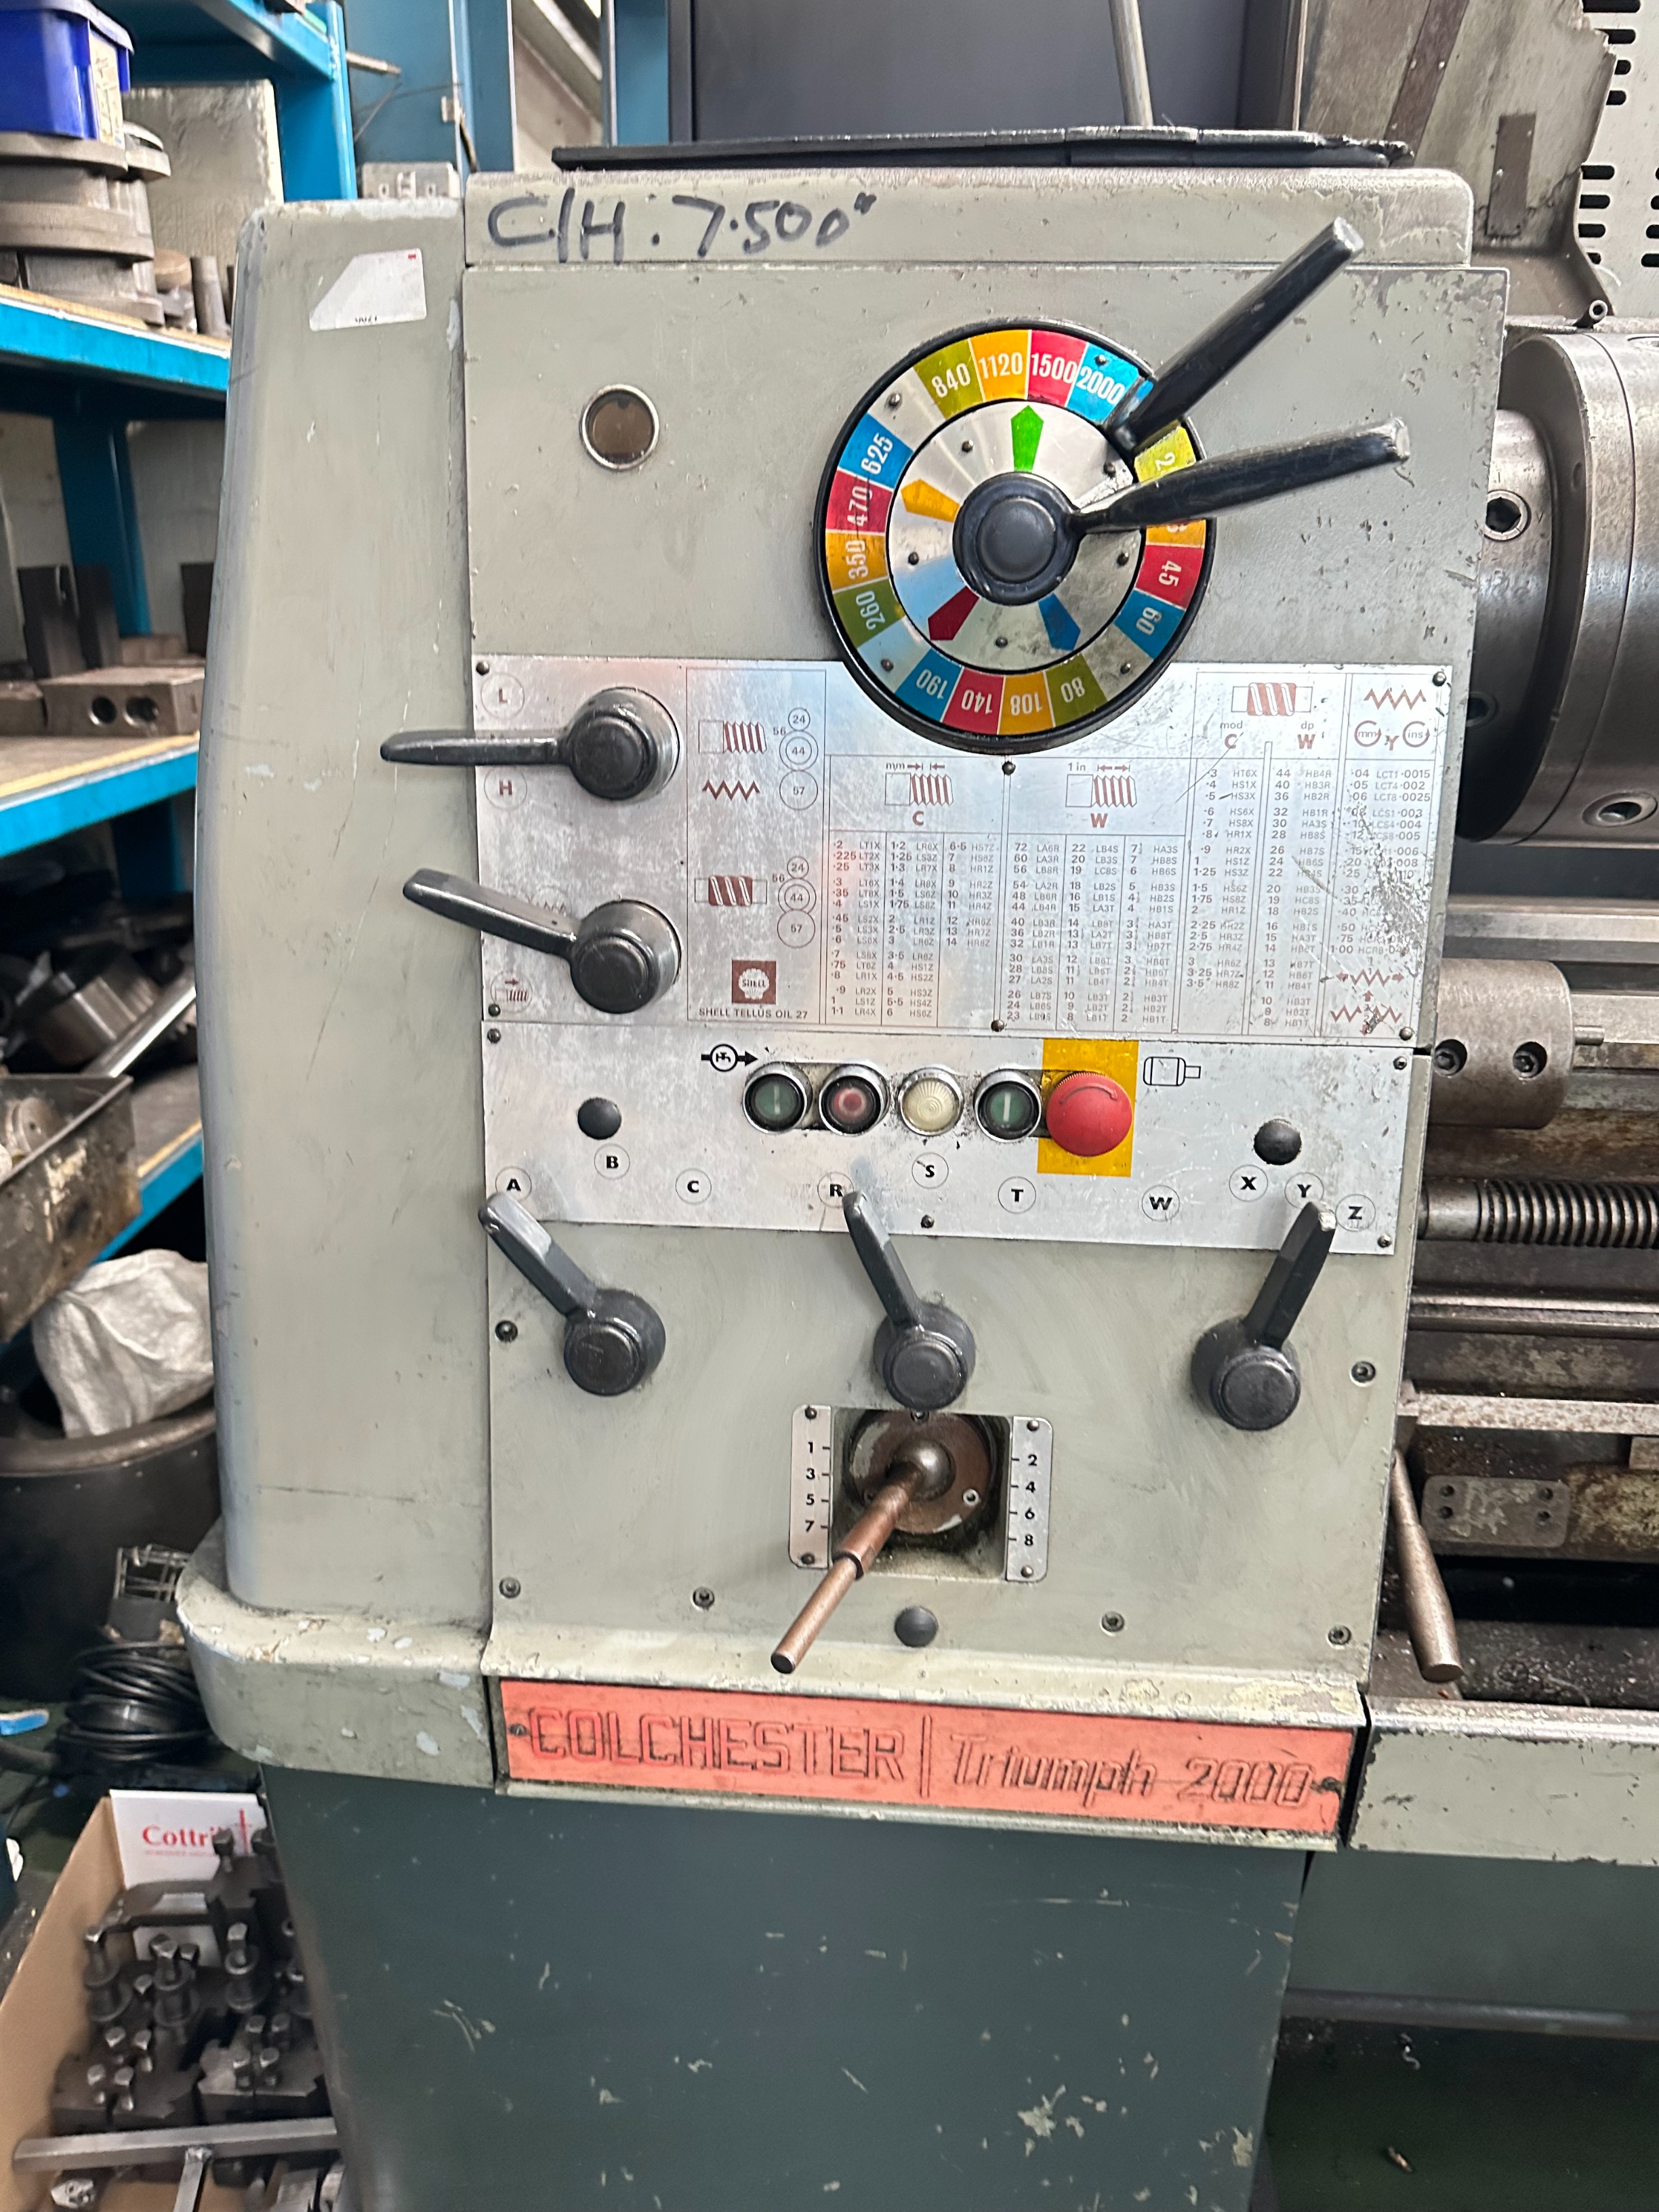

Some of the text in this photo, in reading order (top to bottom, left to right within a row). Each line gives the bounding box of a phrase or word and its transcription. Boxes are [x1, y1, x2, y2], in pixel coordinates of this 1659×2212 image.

[979, 352, 1023, 379] 1120
[1031, 353, 1077, 384] 1500
[931, 363, 971, 398] 840
[1080, 366, 1126, 405] 2000
[861, 432, 893, 474] 625
[1155, 452, 1177, 474] 2
[846, 486, 872, 527] 470
[846, 539, 869, 580] 350
[1159, 560, 1182, 586] 45
[855, 590, 886, 630] 260
[1136, 607, 1163, 634] 60
[916, 668, 949, 700] 190
[1060, 677, 1086, 703] 80
[499, 689, 508, 703] L
[961, 690, 993, 714] 140
[1009, 693, 1042, 714] 108
[793, 716, 805, 724] 24
[1220, 721, 1243, 729] mod
[1301, 721, 1314, 731] dp
[773, 727, 786, 735] 56
[1408, 729, 1423, 738] ins
[1225, 733, 1237, 749] C
[1297, 734, 1315, 749] W
[792, 747, 805, 755] 44
[499, 781, 512, 796] H
[912, 811, 924, 825] C
[1274, 808, 1287, 816] 32
[1090, 813, 1108, 827] W
[1072, 855, 1085, 863] 20
[792, 863, 804, 872] 24
[1130, 867, 1136, 875] 6
[790, 894, 803, 902] 44
[949, 890, 958, 899] 10
[791, 924, 802, 933] 57
[699, 1008, 808, 1019] SHELL TELLUS OIL 27
[607, 1155, 618, 1168] B
[925, 1165, 935, 1178] S
[507, 1178, 521, 1192] A
[687, 1181, 699, 1193] C
[1240, 1176, 1257, 1190] X
[830, 1184, 842, 1197] R
[1010, 1189, 1023, 1202] T
[1298, 1184, 1311, 1198] Y
[1149, 1197, 1173, 1210] W
[1349, 1206, 1363, 1220] Z
[808, 1442, 813, 1453] 1
[1028, 1454, 1038, 1467] 2
[806, 1469, 815, 1479] 3
[1025, 1481, 1036, 1492] 4
[806, 1494, 815, 1505] 5
[1025, 1508, 1035, 1519] 6
[805, 1520, 815, 1532] 7
[1024, 1534, 1033, 1546] 8
[529, 1706, 1317, 1809] COLCHESTER Triumph 2000
